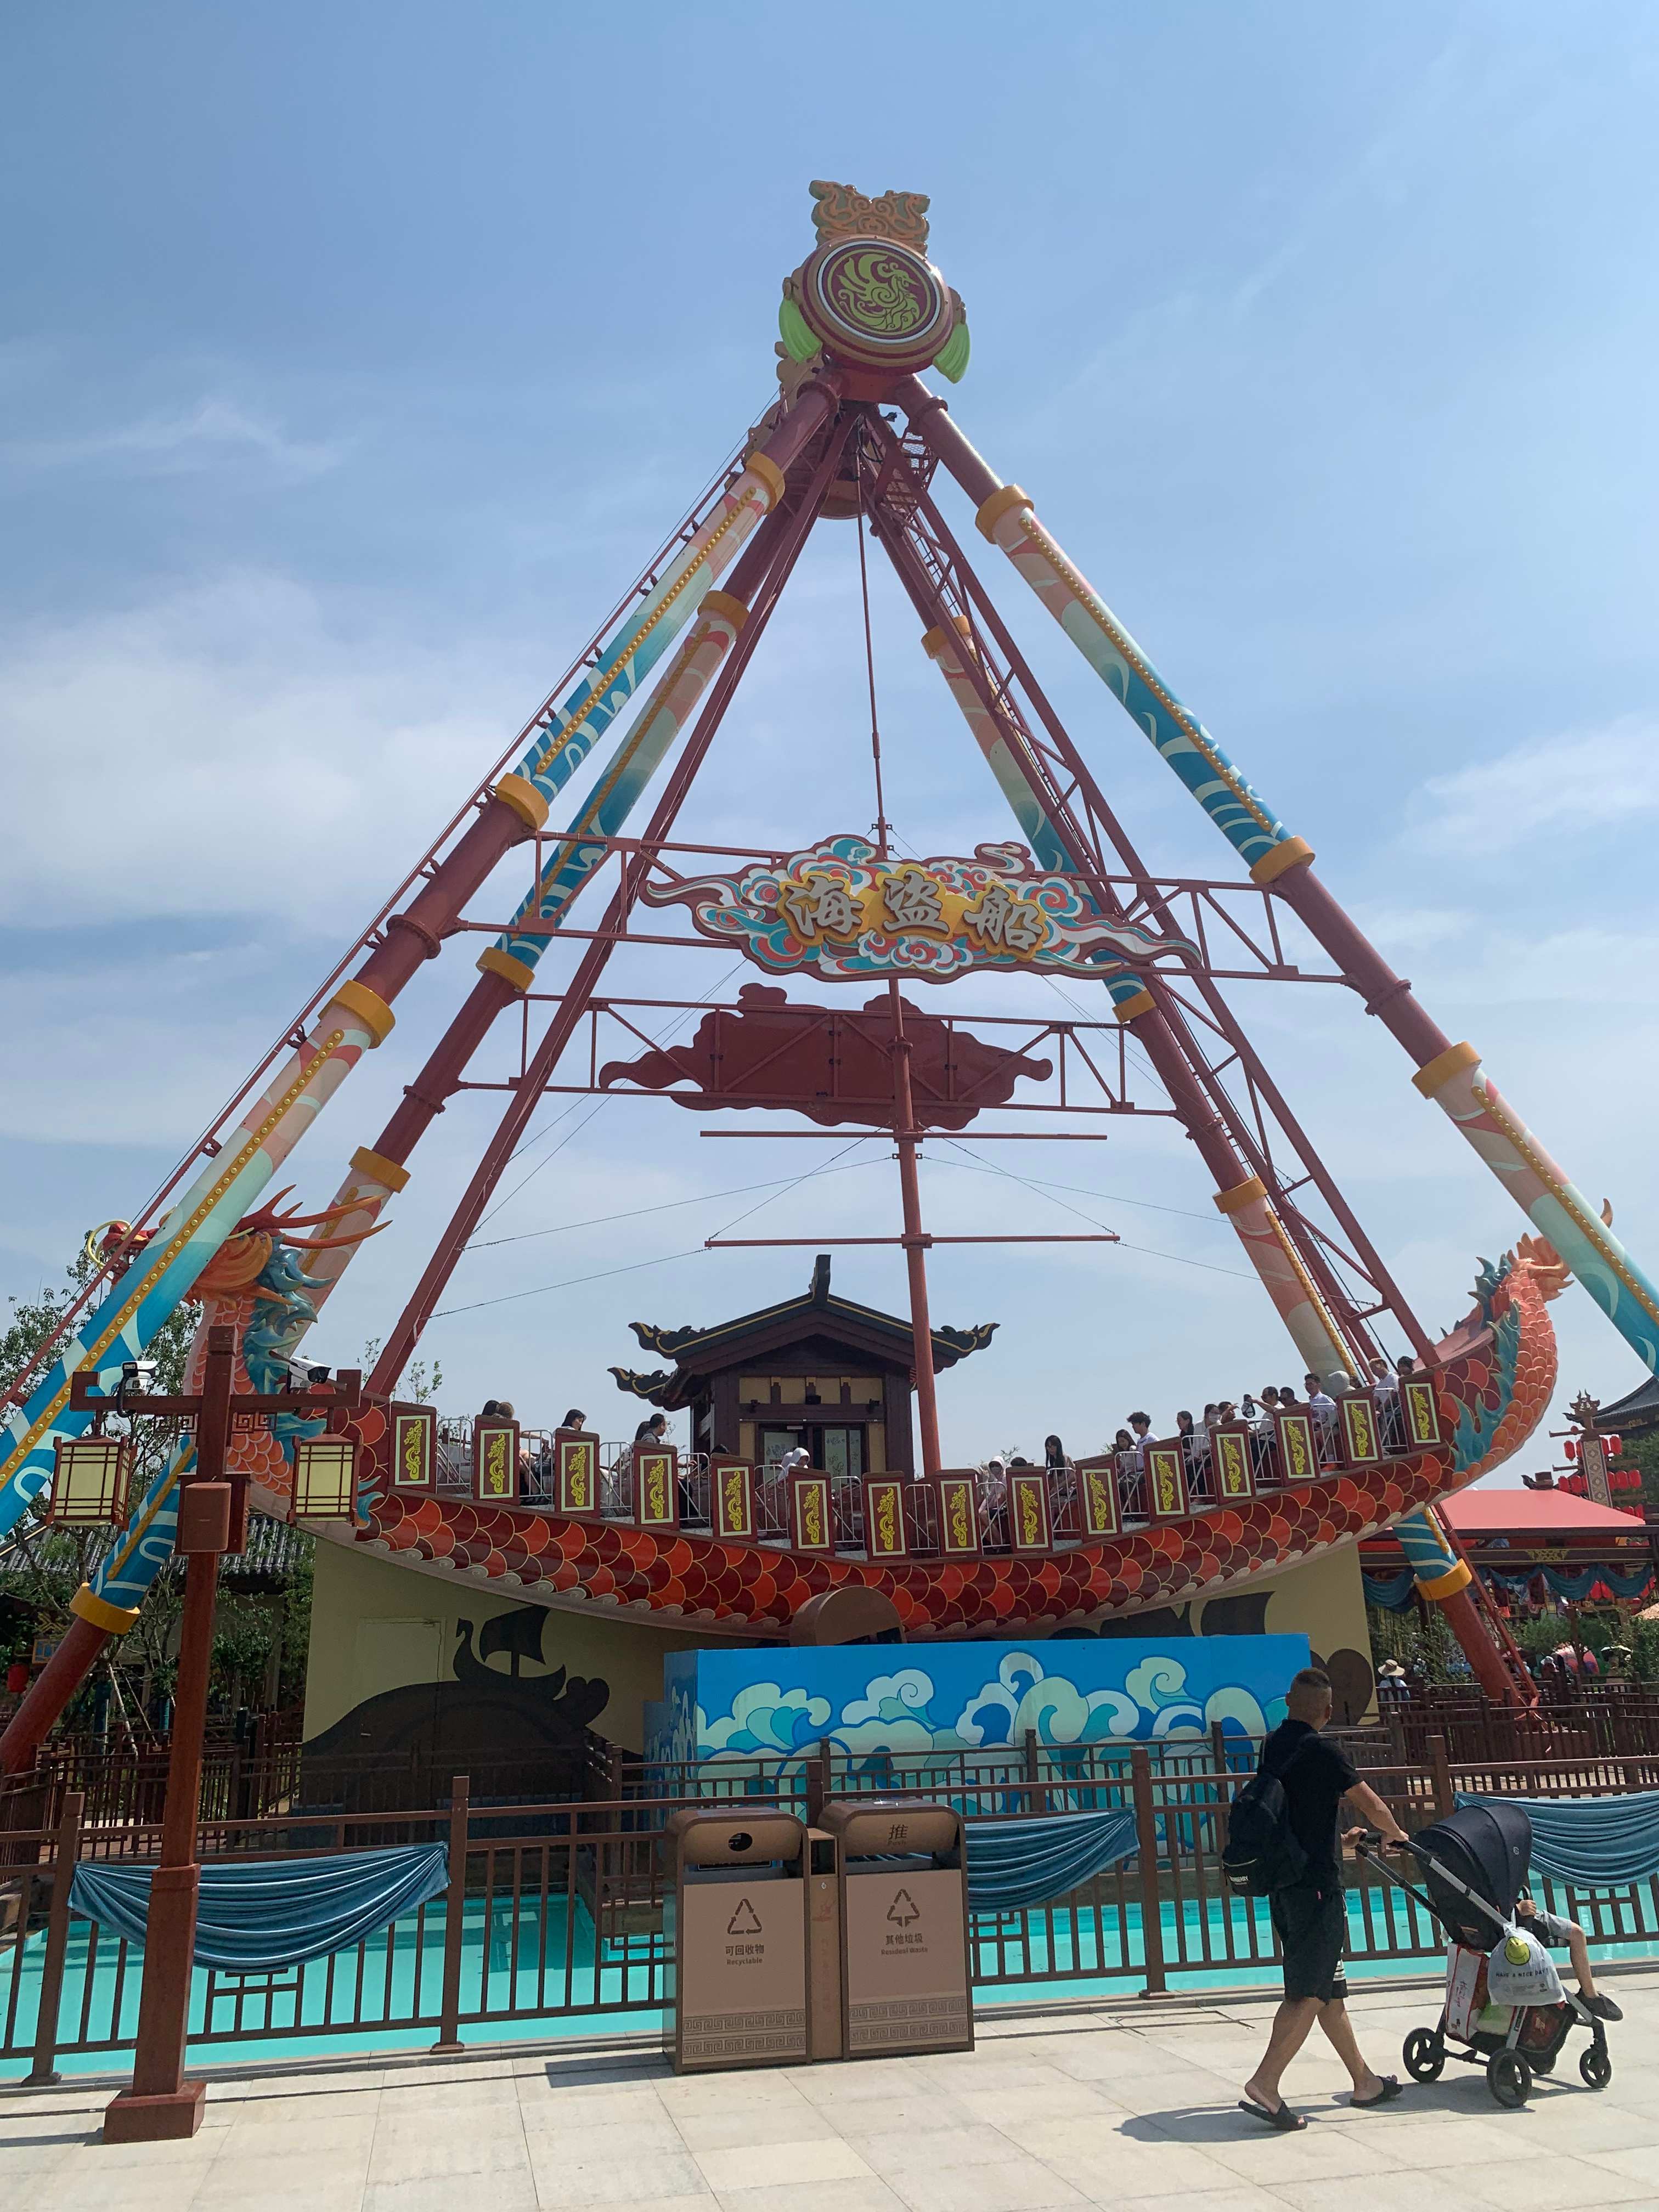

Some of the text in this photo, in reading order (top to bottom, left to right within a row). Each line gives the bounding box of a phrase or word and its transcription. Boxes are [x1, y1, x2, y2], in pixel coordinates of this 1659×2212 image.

[785, 870, 1043, 953] 海盗船
[889, 1824, 909, 1839] 推
[885, 1932, 923, 1945] 其他垃圾
[725, 1944, 764, 1956] 可回收物
[727, 1957, 763, 1966] Recyclable
